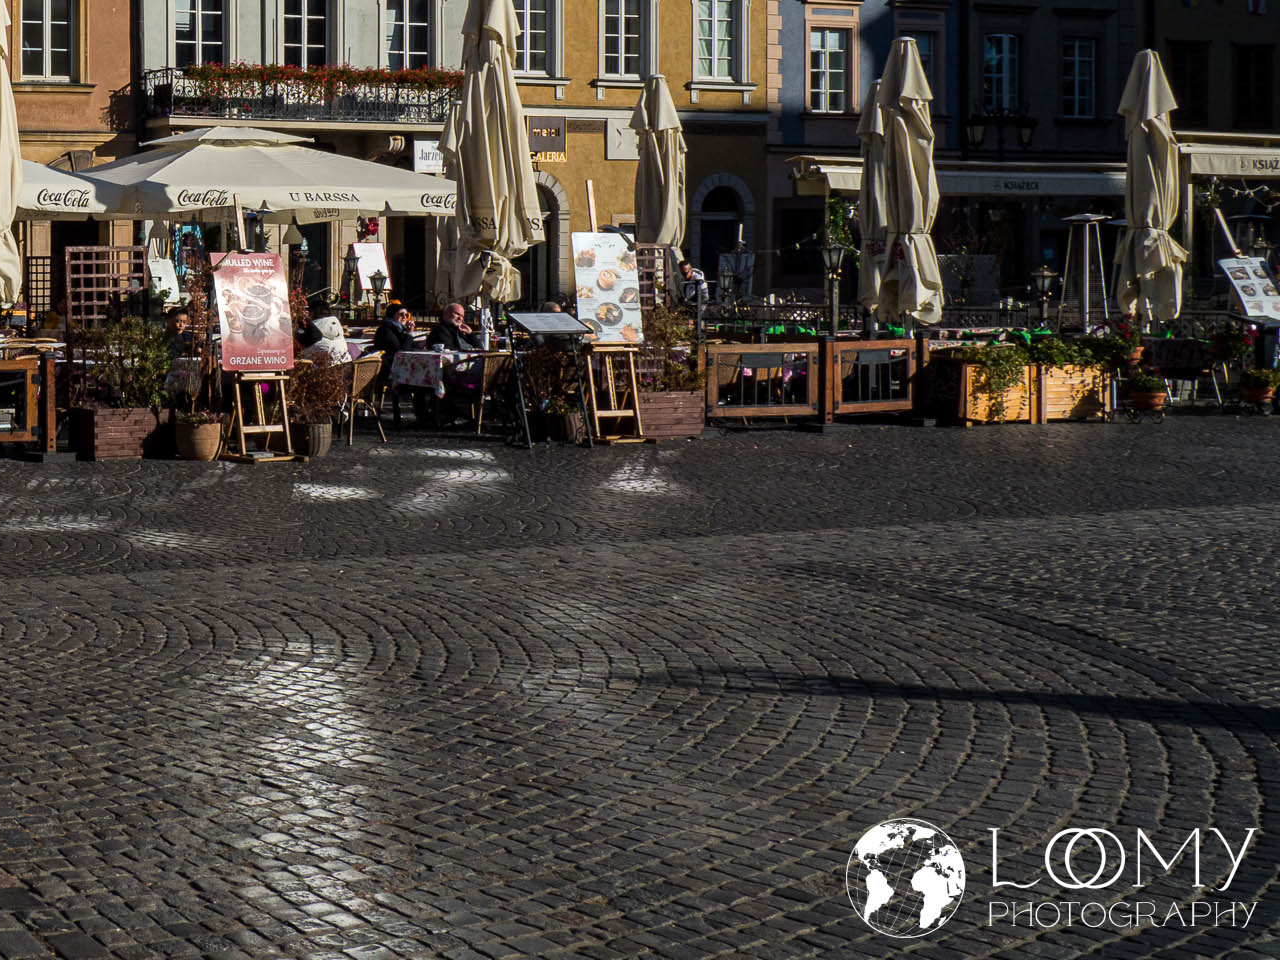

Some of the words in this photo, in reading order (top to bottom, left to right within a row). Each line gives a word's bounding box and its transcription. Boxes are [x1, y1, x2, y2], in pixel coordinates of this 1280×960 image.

[529, 151, 566, 162] GALERIA
[1253, 157, 1280, 172] KSIĄŻ
[289, 192, 300, 202] U
[304, 193, 360, 202] BARSSA
[253, 258, 275, 267] WINE
[229, 356, 262, 366] GRZANE
[263, 356, 287, 365] WINO
